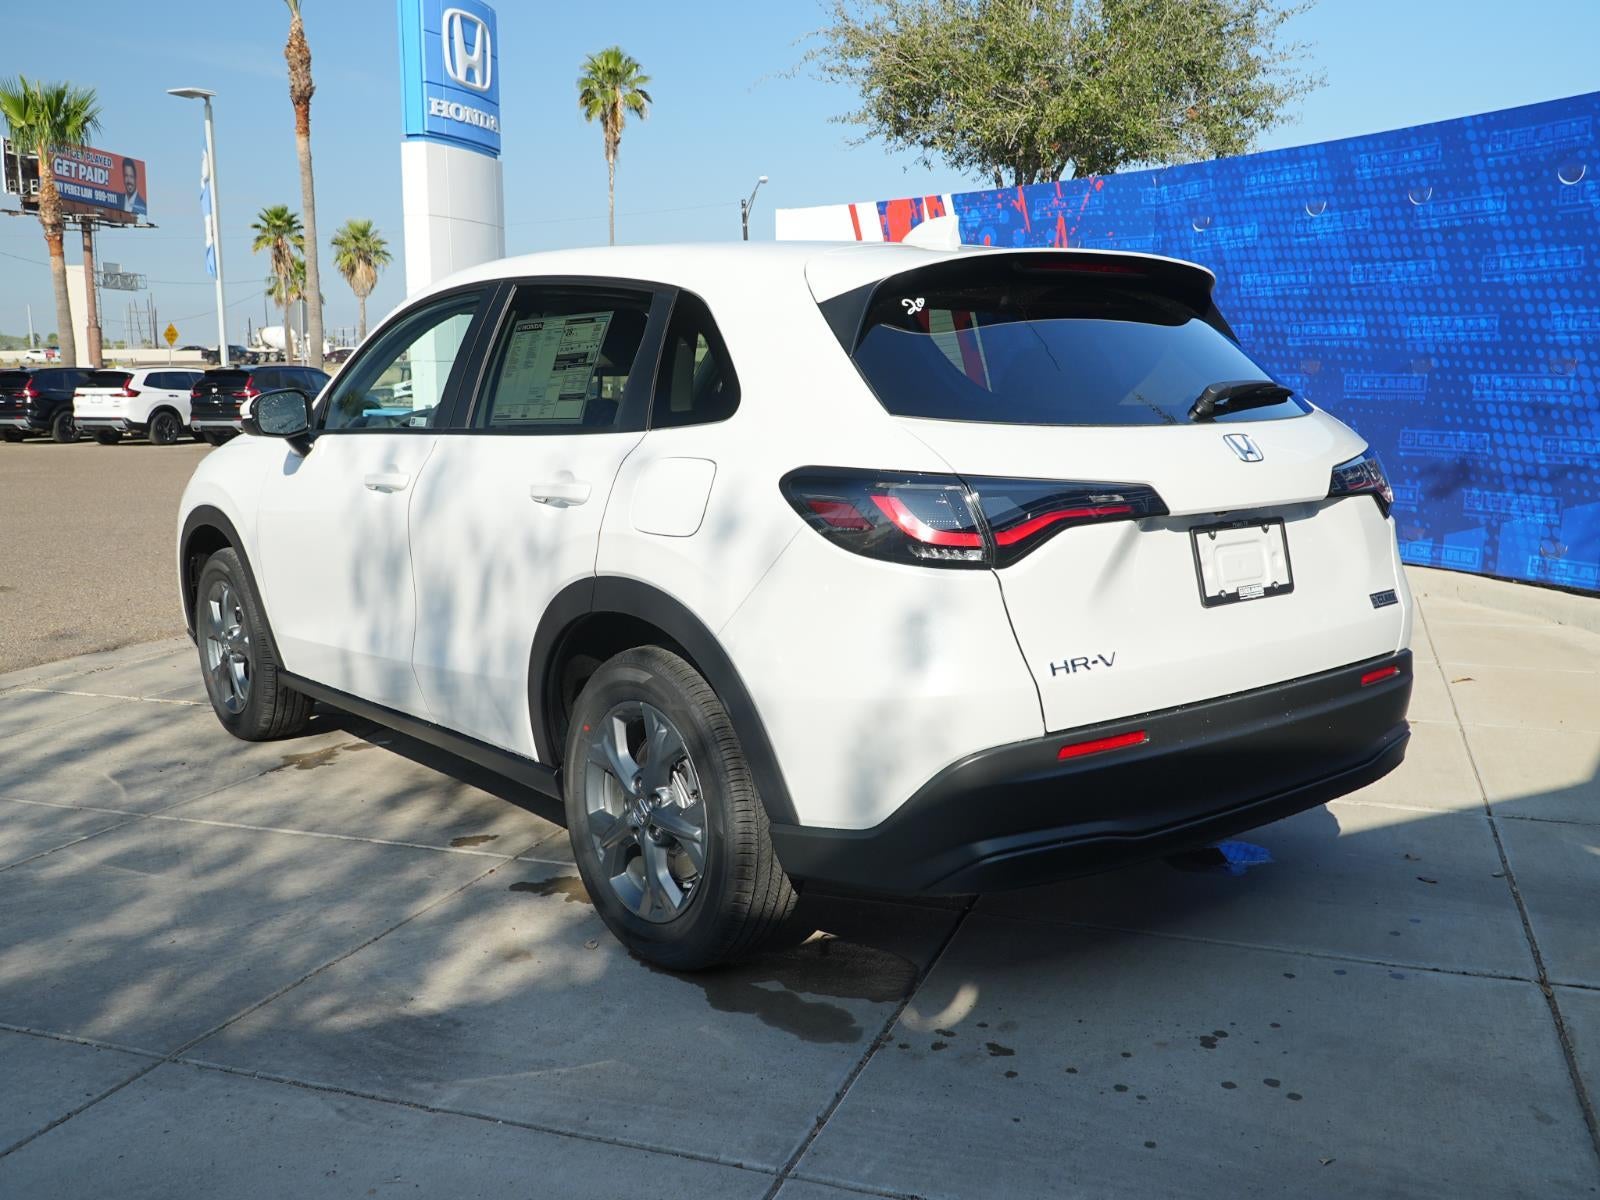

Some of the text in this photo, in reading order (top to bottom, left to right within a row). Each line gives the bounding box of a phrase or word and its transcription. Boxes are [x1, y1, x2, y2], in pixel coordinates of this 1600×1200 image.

[428, 97, 500, 134] HONDA
[54, 158, 109, 186] GET PAID!
[64, 183, 81, 196] PEREZ
[1418, 434, 1486, 449] CLARK
[1050, 651, 1115, 677] HR-V
